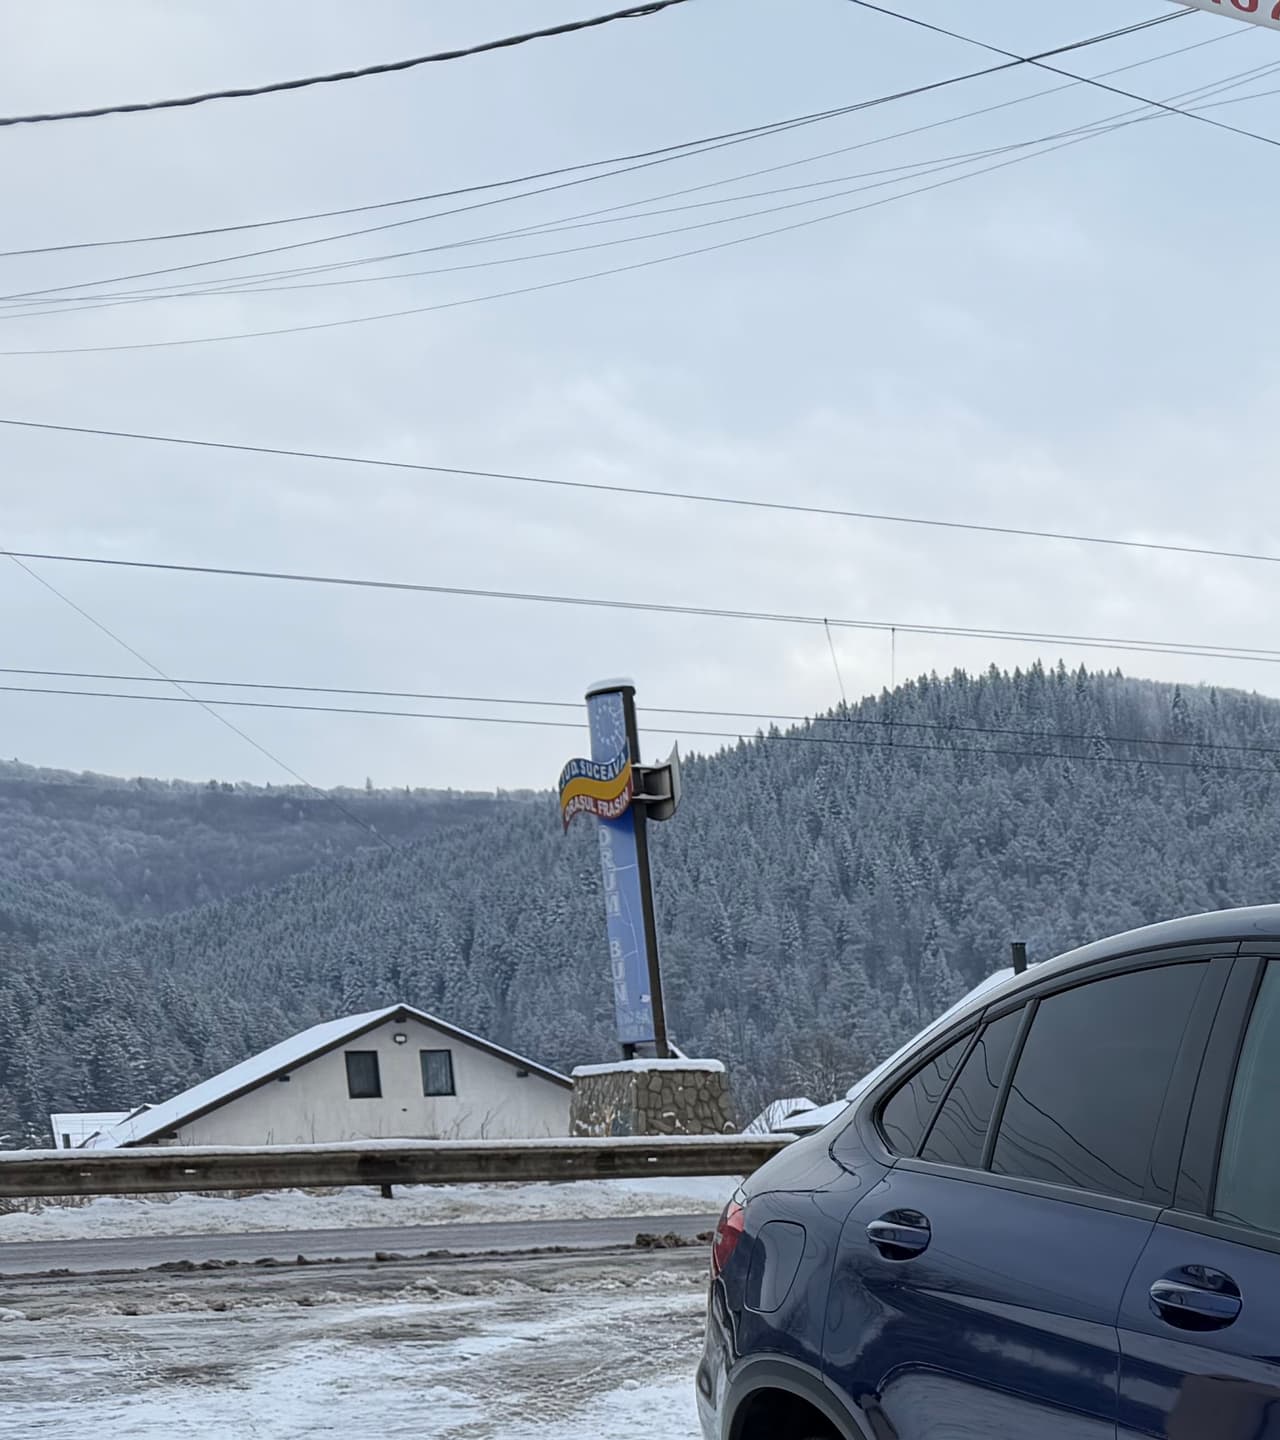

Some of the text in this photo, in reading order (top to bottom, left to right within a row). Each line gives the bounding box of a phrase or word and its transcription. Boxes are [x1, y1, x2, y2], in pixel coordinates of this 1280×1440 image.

[580, 751, 626, 781] SUCEAVA
[597, 787, 629, 818] FRASIN
[609, 937, 629, 1006] BUN
